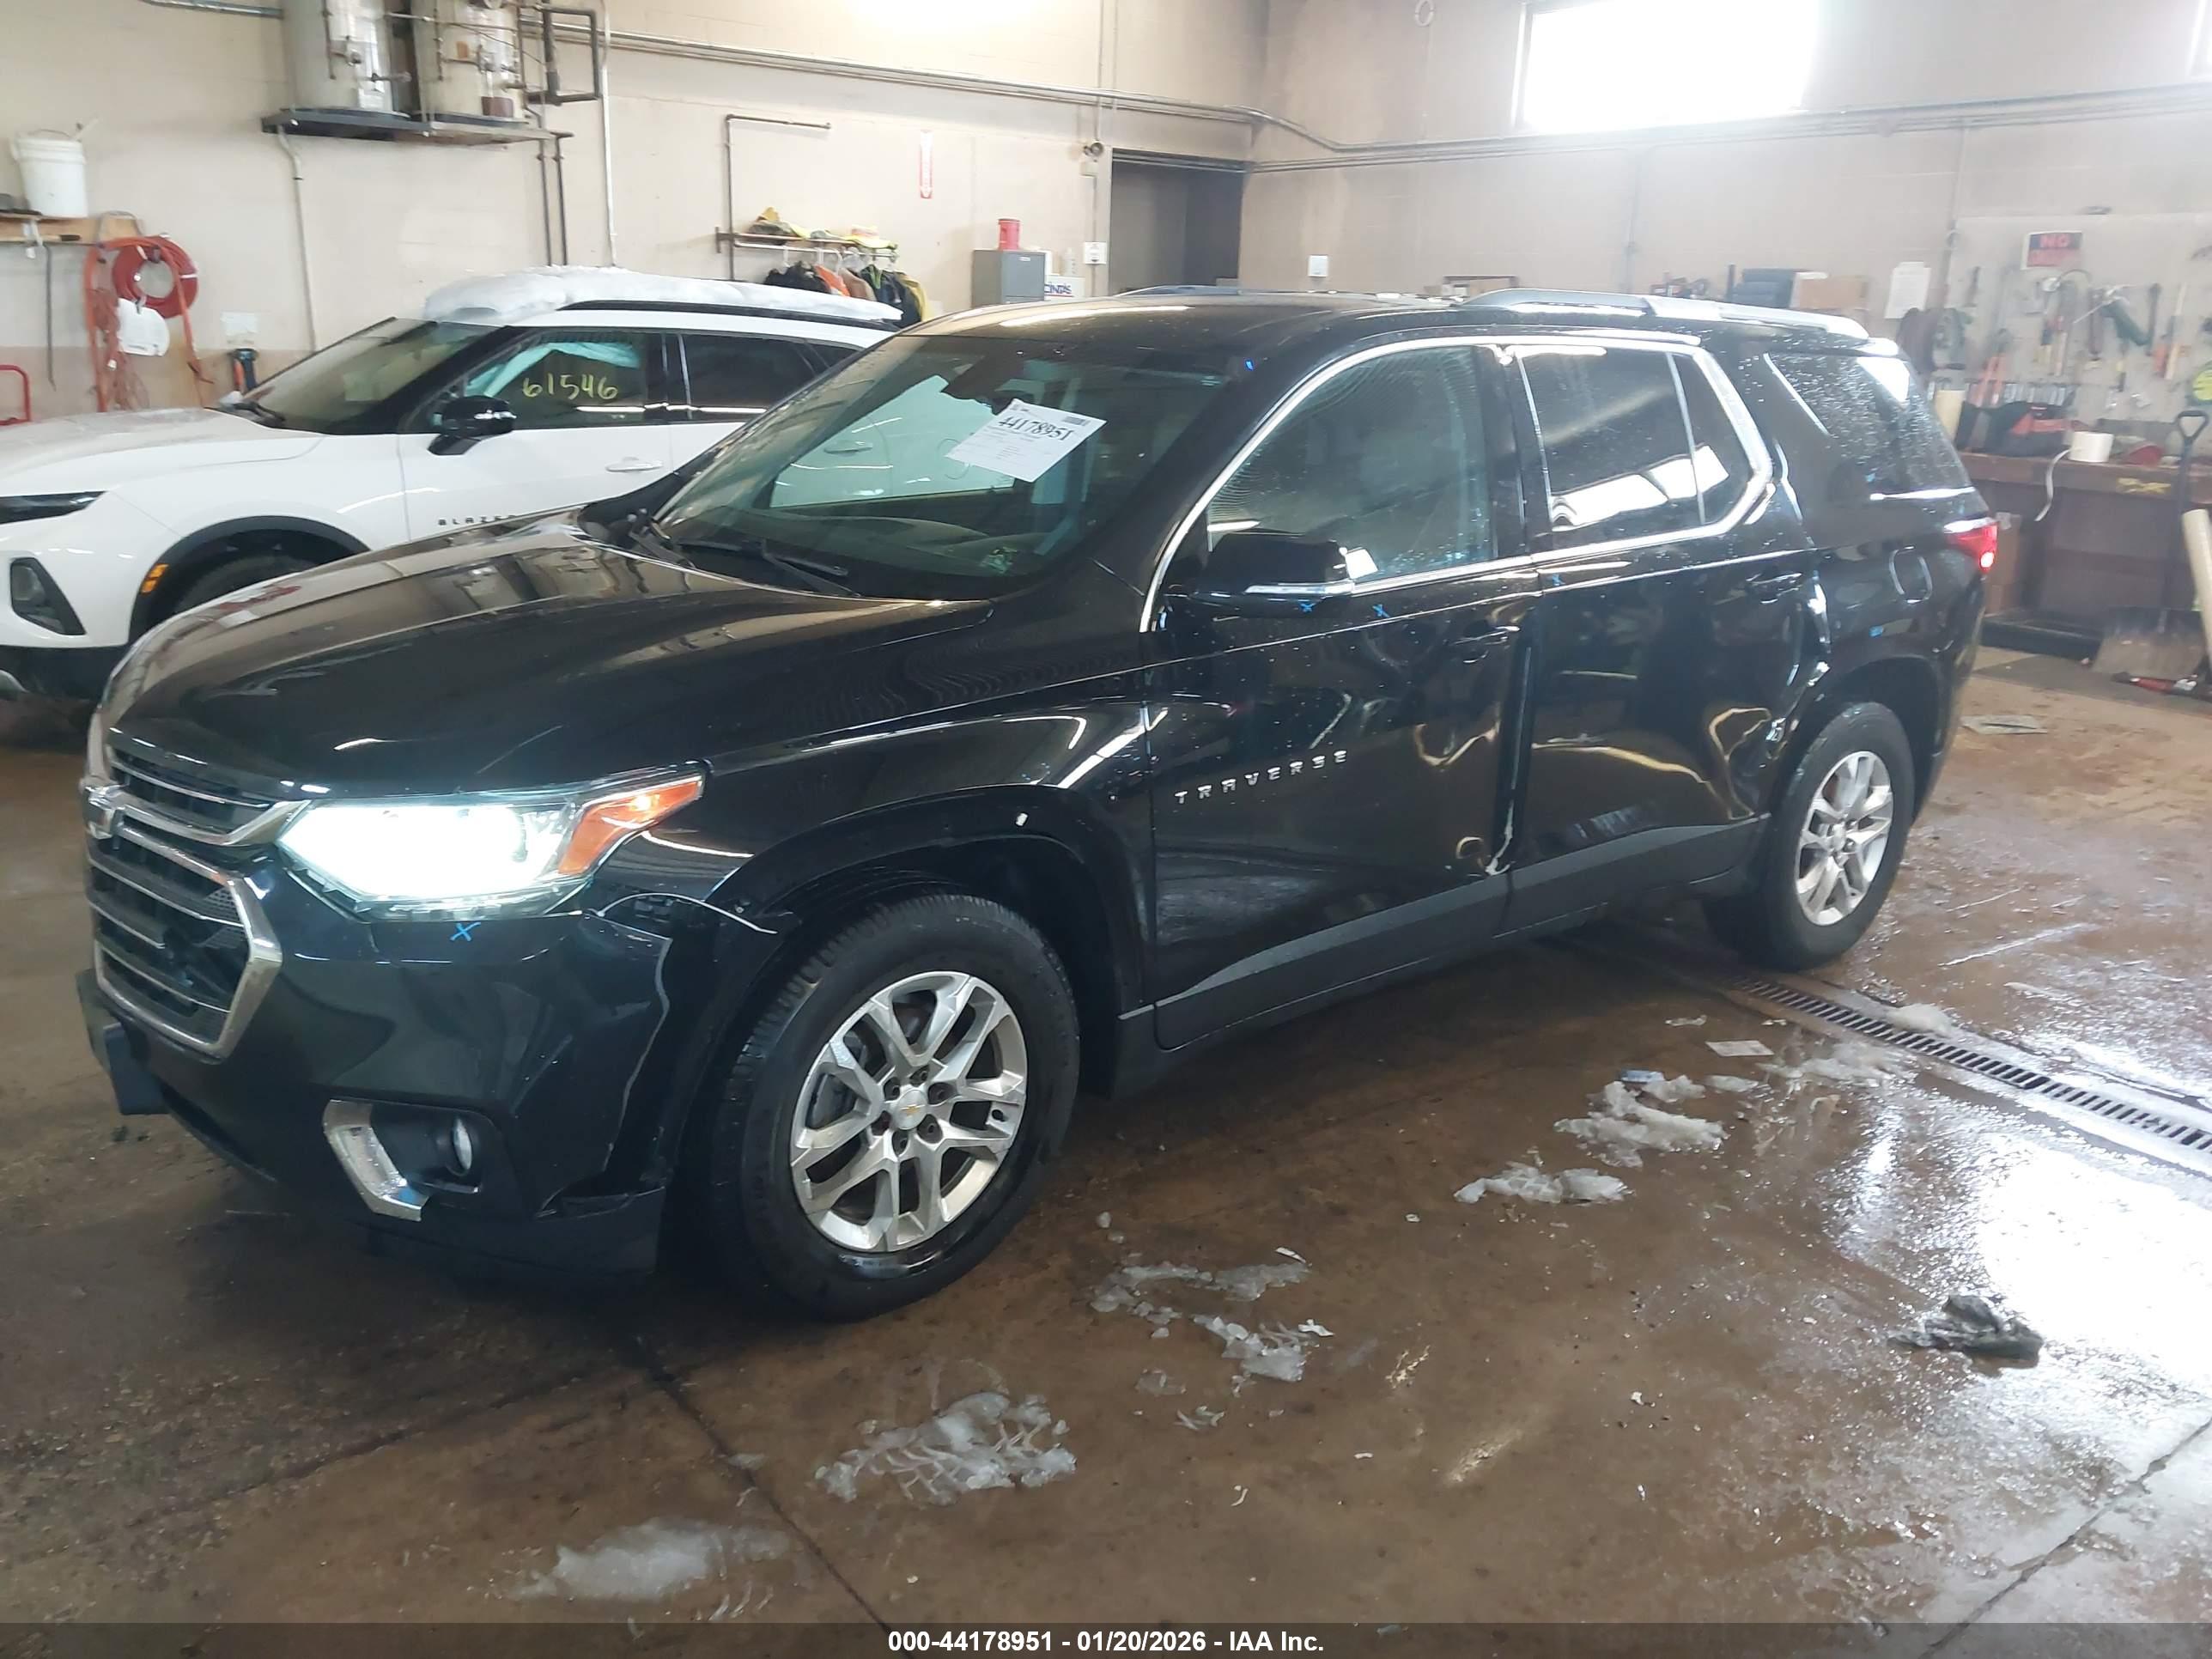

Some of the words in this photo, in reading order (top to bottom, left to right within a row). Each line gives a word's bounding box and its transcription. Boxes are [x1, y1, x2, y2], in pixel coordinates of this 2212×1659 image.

[522, 373, 619, 400] 61546
[997, 416, 1074, 441] 44178951
[1174, 750, 1347, 804] TRAVERSE
